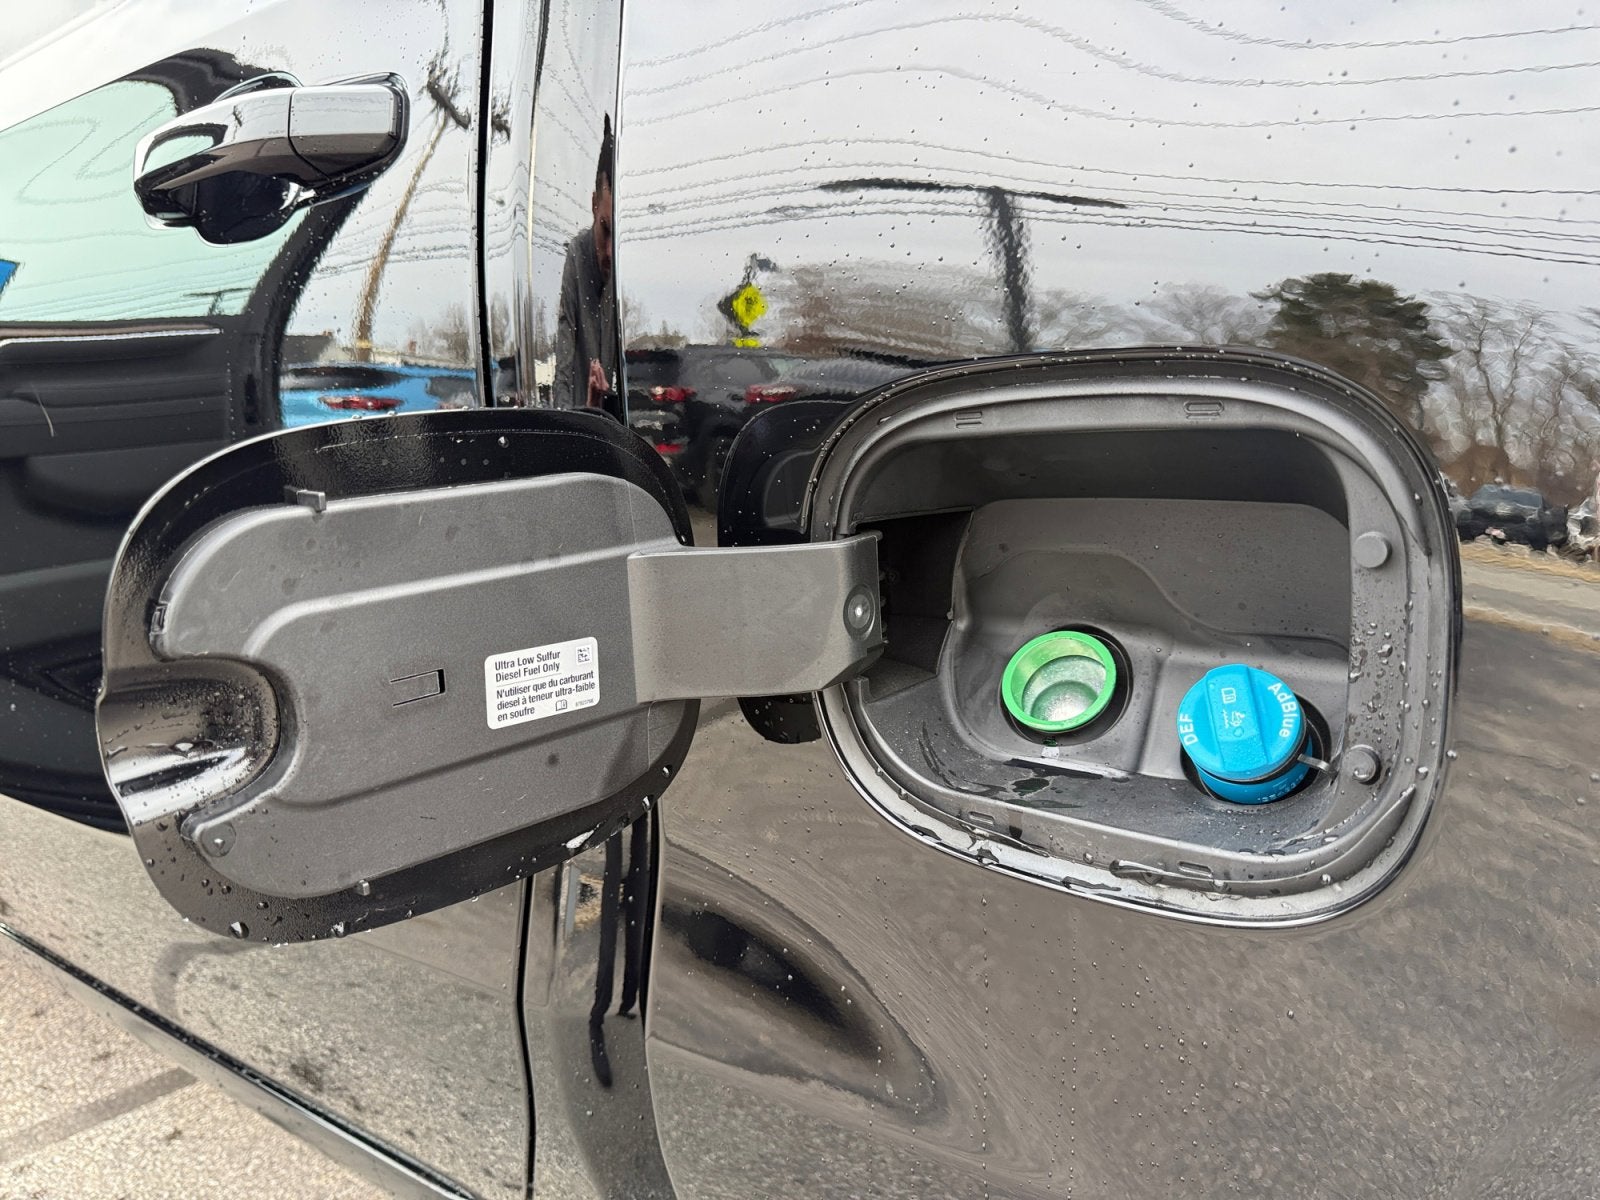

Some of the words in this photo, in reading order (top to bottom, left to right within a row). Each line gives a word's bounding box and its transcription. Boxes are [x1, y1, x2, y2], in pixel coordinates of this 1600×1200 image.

[495, 660, 515, 671] Ultra
[517, 657, 534, 667] Low
[536, 651, 561, 663] Sulfur
[495, 669, 521, 682] Diesel
[523, 665, 541, 677] Fuel
[543, 662, 560, 672] Only
[496, 686, 531, 699] N'utiliser
[532, 682, 547, 693] que
[548, 678, 558, 687] du
[559, 670, 594, 685] carburant
[497, 697, 520, 711] diesel
[522, 695, 527, 705] à
[529, 692, 553, 703] teneur
[555, 682, 596, 697] ultra-faible
[497, 712, 508, 722] en
[509, 706, 535, 718] soufre
[1267, 682, 1298, 738] AdBlue
[1179, 713, 1199, 746] DEF
